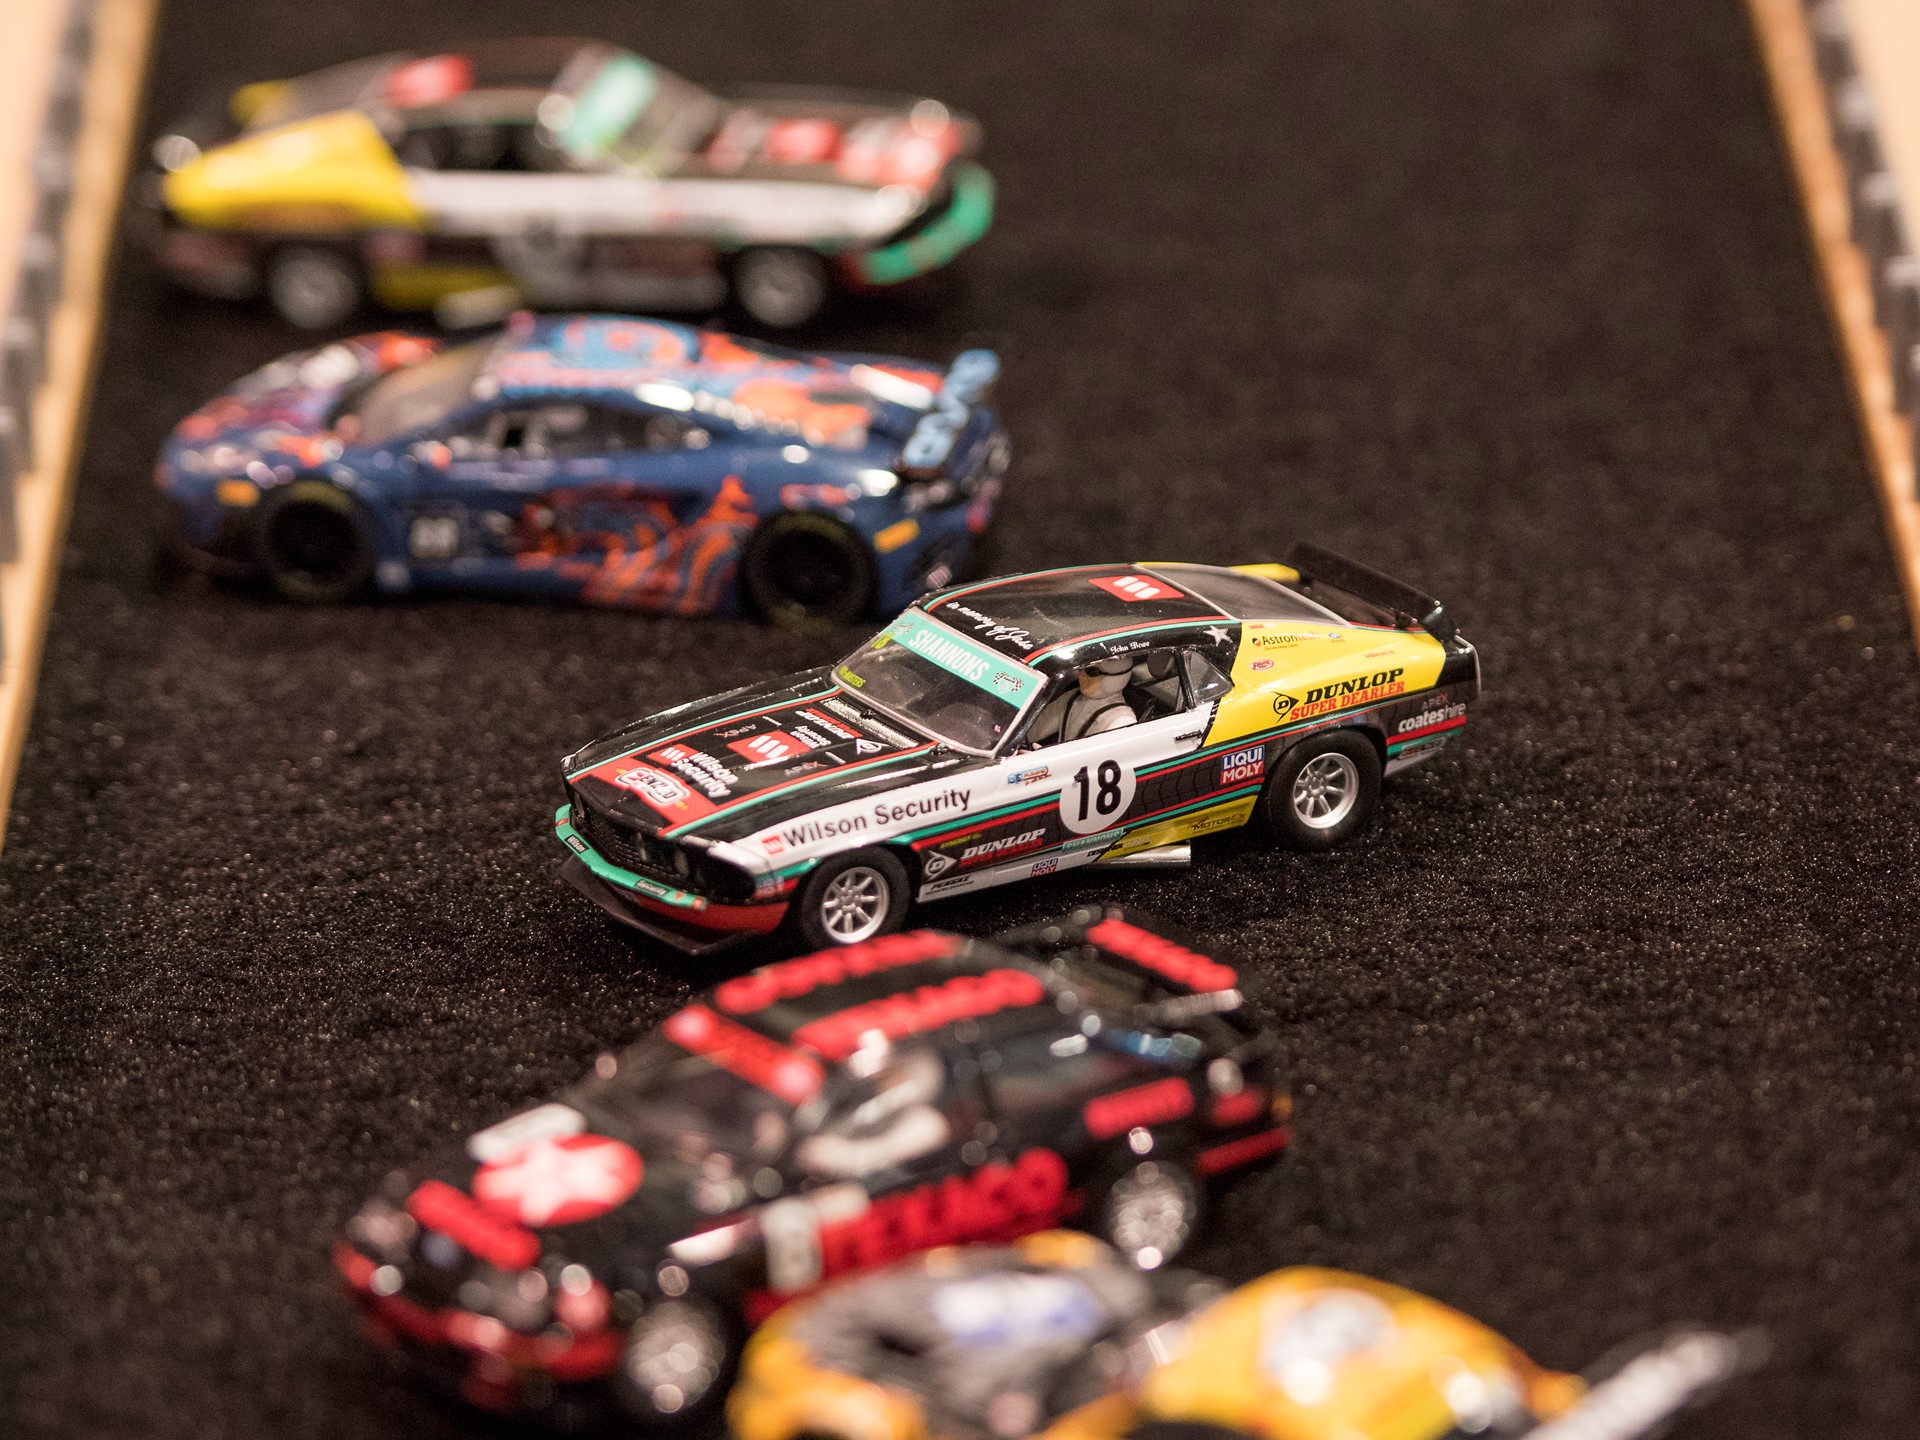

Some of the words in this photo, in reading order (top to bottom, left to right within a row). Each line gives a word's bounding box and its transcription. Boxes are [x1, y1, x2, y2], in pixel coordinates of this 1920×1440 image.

[908, 628, 991, 682] SHANNONS
[1289, 700, 1338, 722] SUPER
[1340, 681, 1405, 708] DEARLER
[1304, 668, 1404, 705] DUNLOP
[688, 752, 739, 786] Wilson
[1222, 761, 1263, 784] MOLY
[1223, 748, 1264, 766] LIQUI
[1074, 759, 1121, 822] 18
[782, 815, 868, 848] Wilson
[874, 788, 972, 825] Security
[960, 828, 1046, 860] DUNLOP
[1031, 865, 1057, 878] MOLY
[1033, 858, 1058, 871] LIQUI
